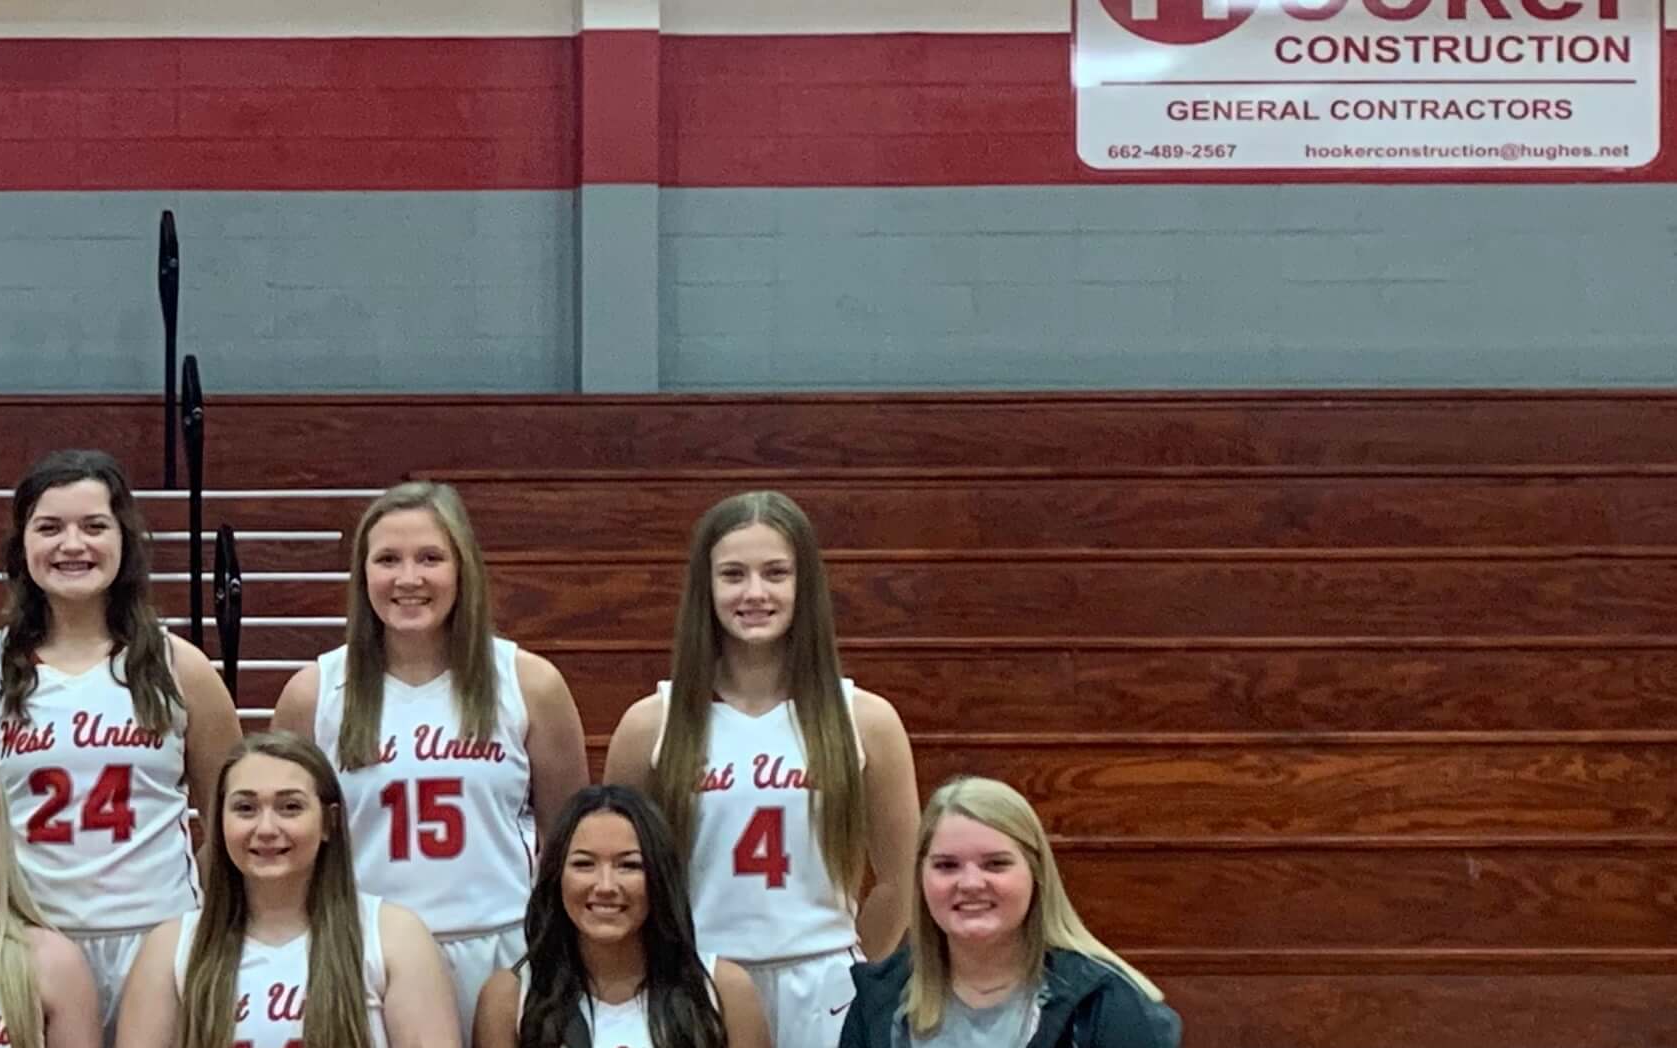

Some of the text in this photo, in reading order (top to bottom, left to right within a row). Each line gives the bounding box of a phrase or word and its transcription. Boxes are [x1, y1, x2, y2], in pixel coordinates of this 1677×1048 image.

[1275, 35, 1631, 64] CONSTRUCTION
[1166, 98, 1573, 121] GENERAL CONTRACTORS
[1107, 144, 1237, 160] 662-489-2567
[1305, 143, 1630, 161] hookerconstruction@hughes.net
[0, 710, 164, 759] West Union
[414, 724, 506, 763] Union
[27, 763, 137, 843] 24
[380, 777, 466, 862] 15
[732, 806, 790, 890] 4
